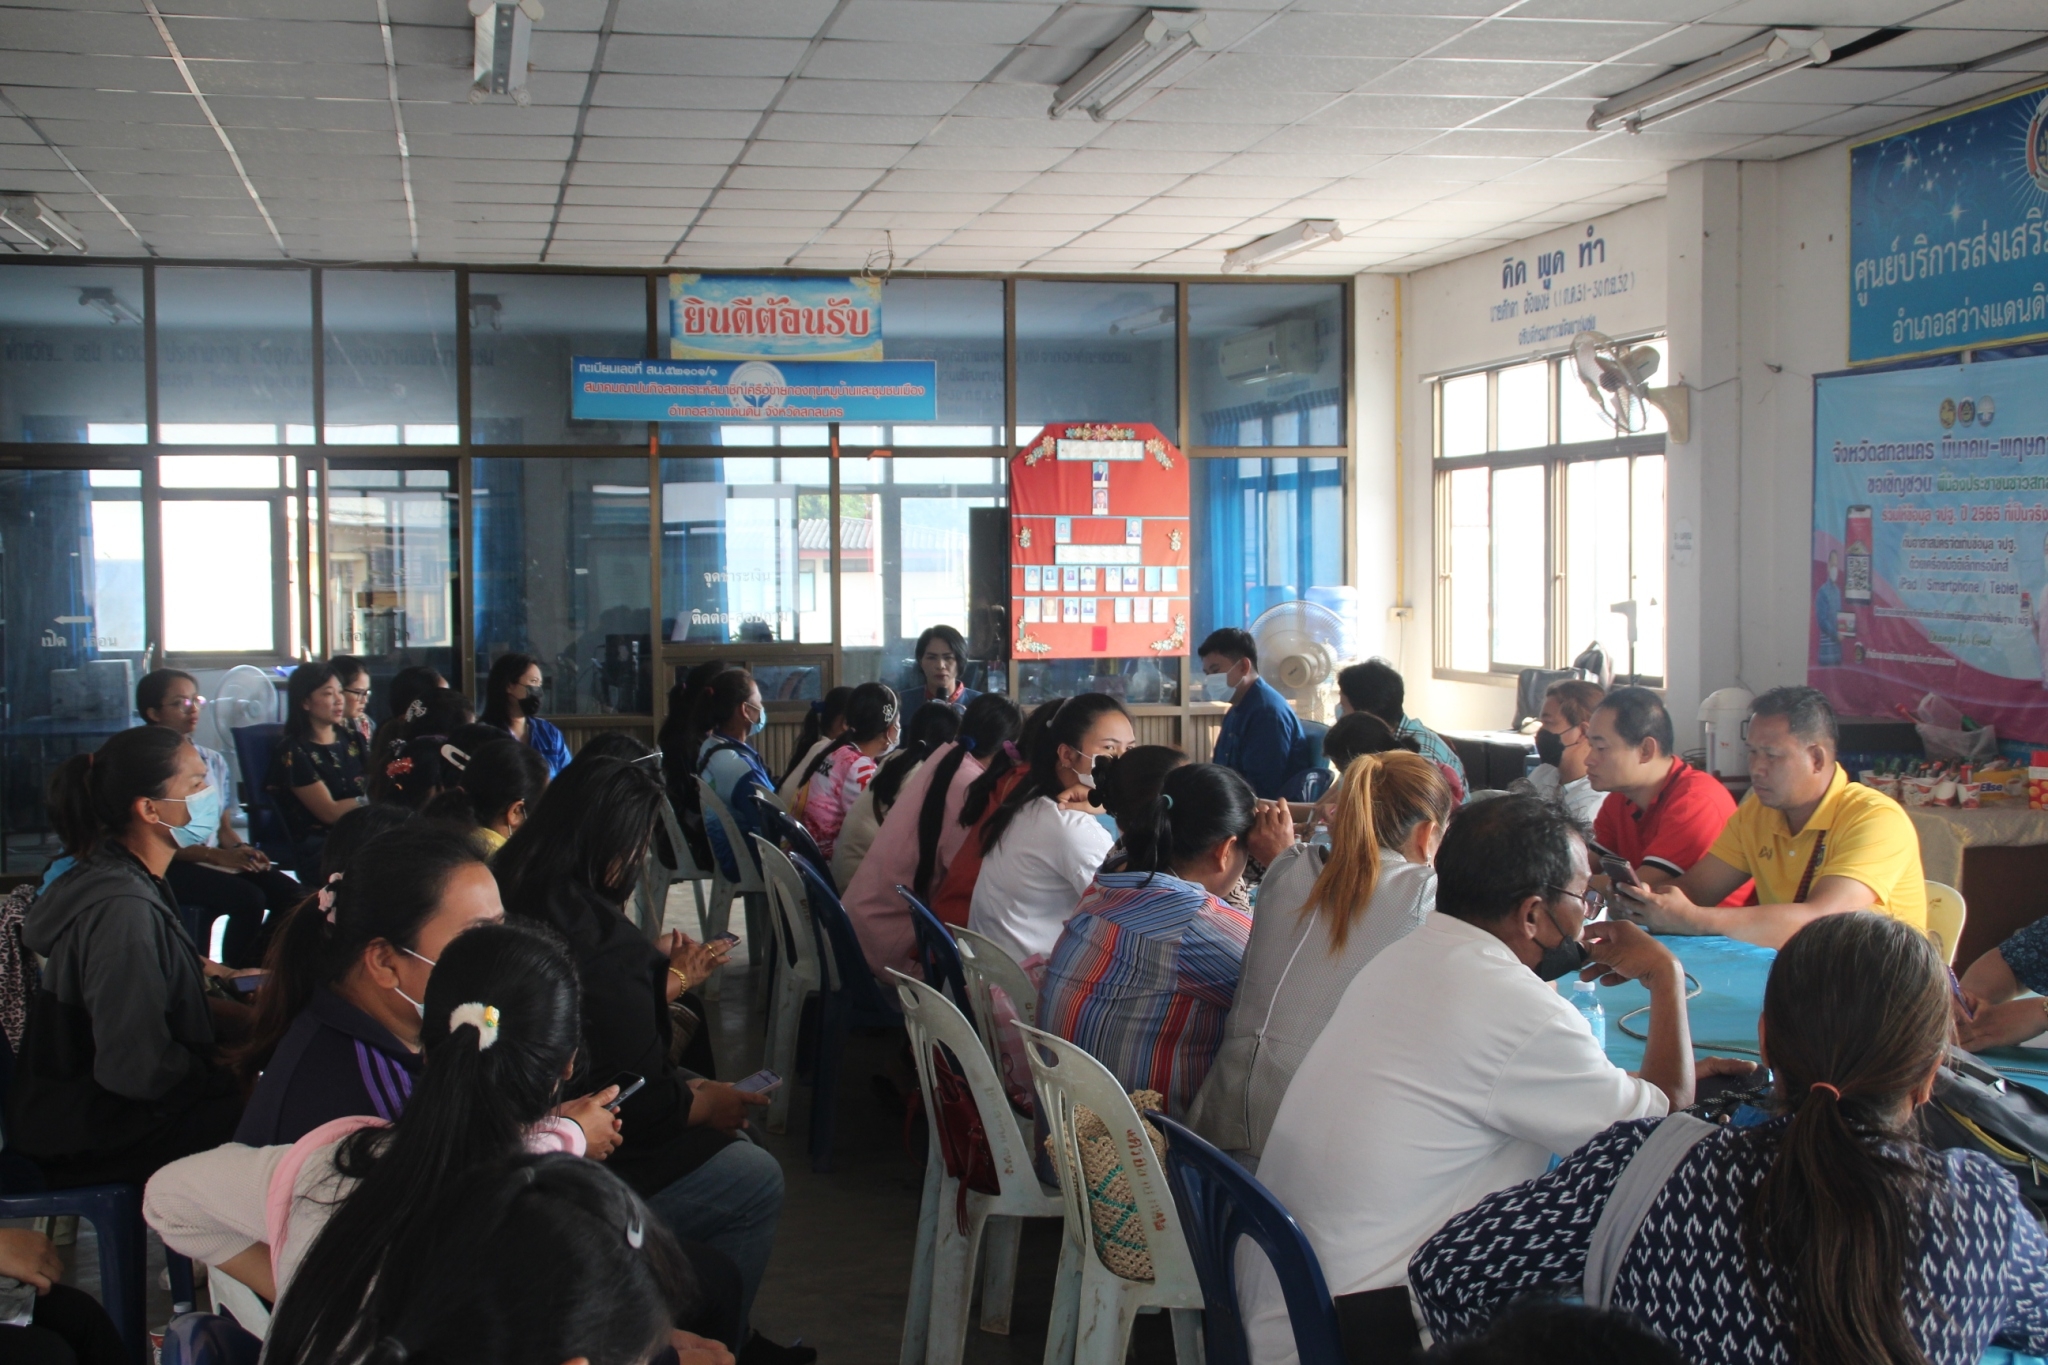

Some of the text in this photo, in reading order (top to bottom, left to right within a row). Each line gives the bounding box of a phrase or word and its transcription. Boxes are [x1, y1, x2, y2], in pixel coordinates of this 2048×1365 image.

[1502, 225, 1605, 291] คิด พูด ทำ
[683, 296, 870, 336] ยินดีต้อนรับ
[1892, 282, 2048, 344] อำเภอสว่างแดนดิ
[579, 361, 642, 375] ทะเบียนเลขที่
[668, 402, 844, 418] อำเภอสว่างแดนดิน จังหวัดสกลนคร
[1832, 432, 2048, 463] จังหวัดสกลนคร มีนาคม-พฤษภ
[1867, 471, 1932, 498] ขอเชิญชวน
[1971, 506, 2000, 522] 2565
[1926, 578, 1980, 594] Smartphone
[41, 629, 67, 647] เปิด
